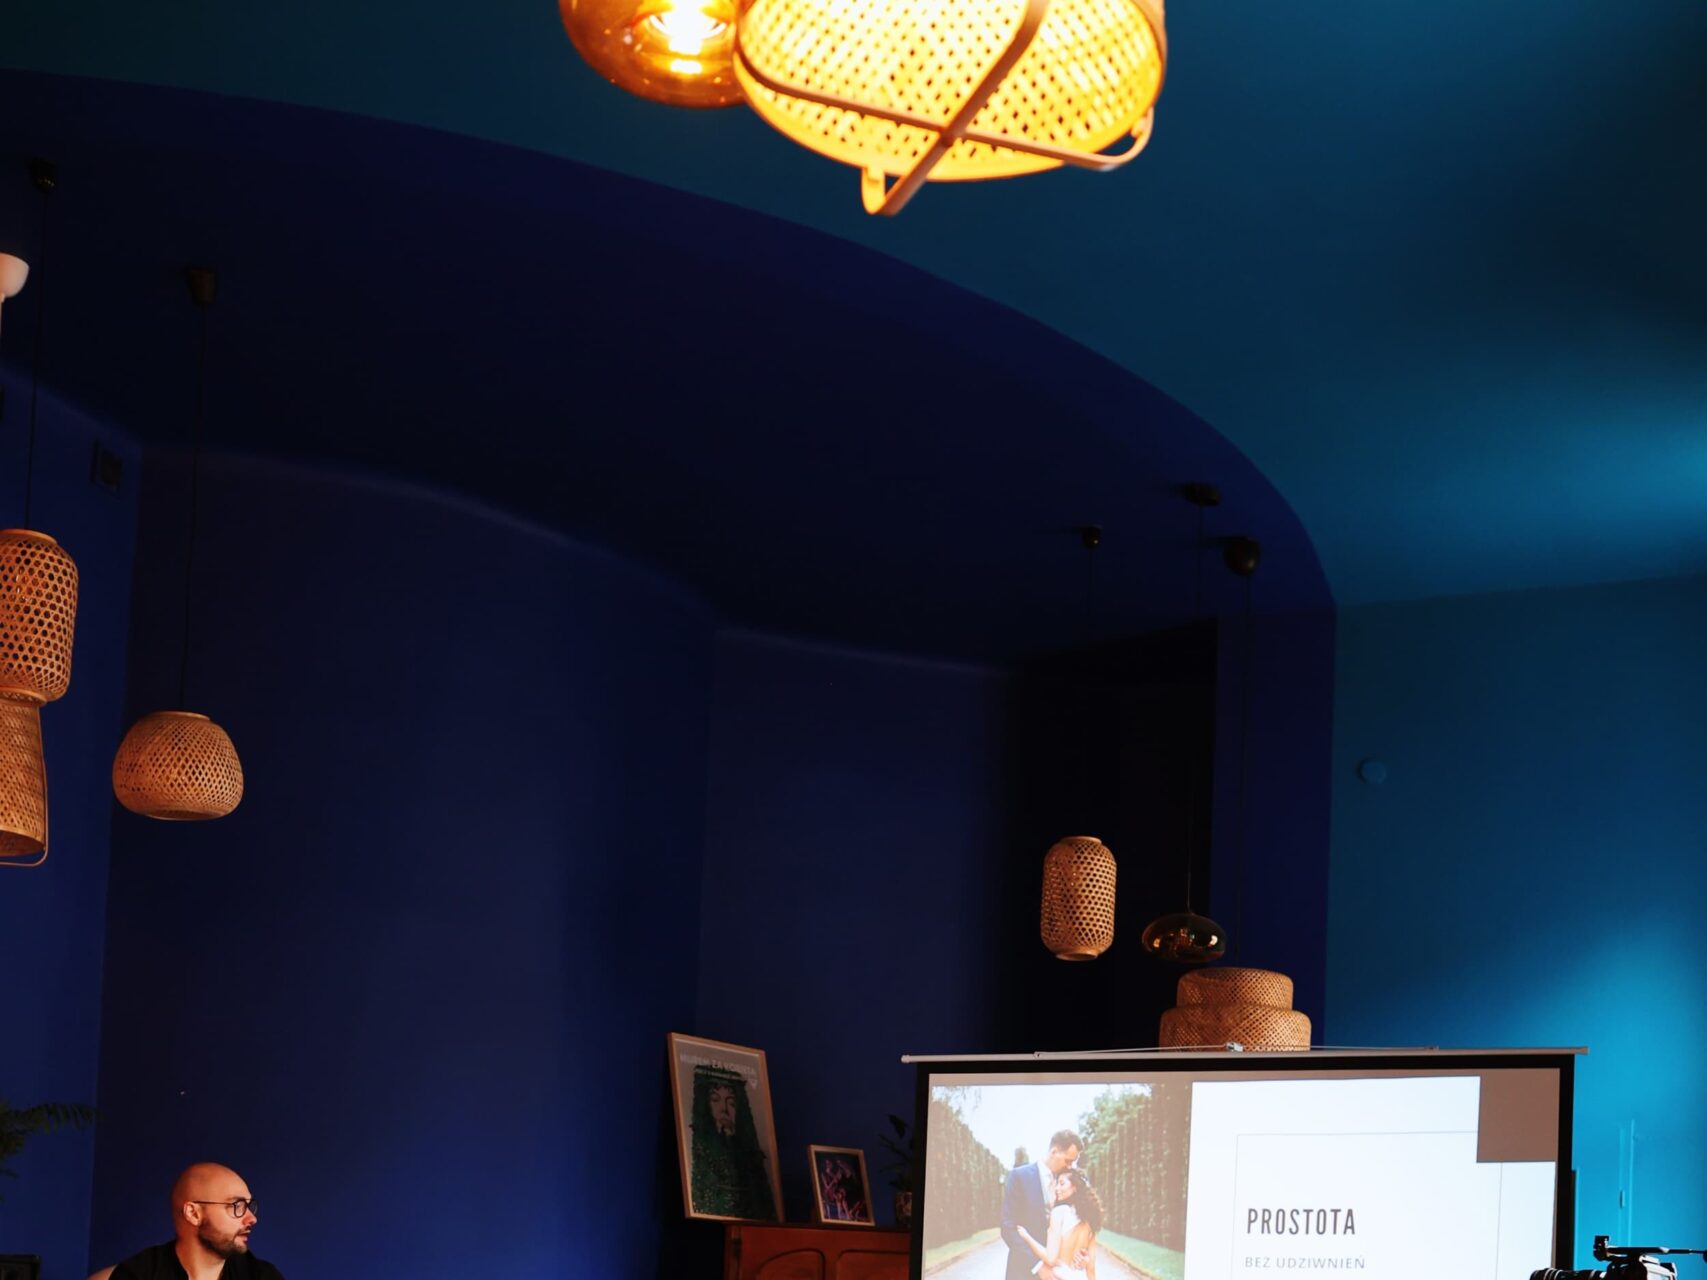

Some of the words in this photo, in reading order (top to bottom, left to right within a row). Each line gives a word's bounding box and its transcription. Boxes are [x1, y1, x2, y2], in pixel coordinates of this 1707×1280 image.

[1247, 1208, 1356, 1235] PROSTOTA
[1245, 1257, 1271, 1268] BEZ
[1276, 1255, 1365, 1269] UDZIWNIEŃ
